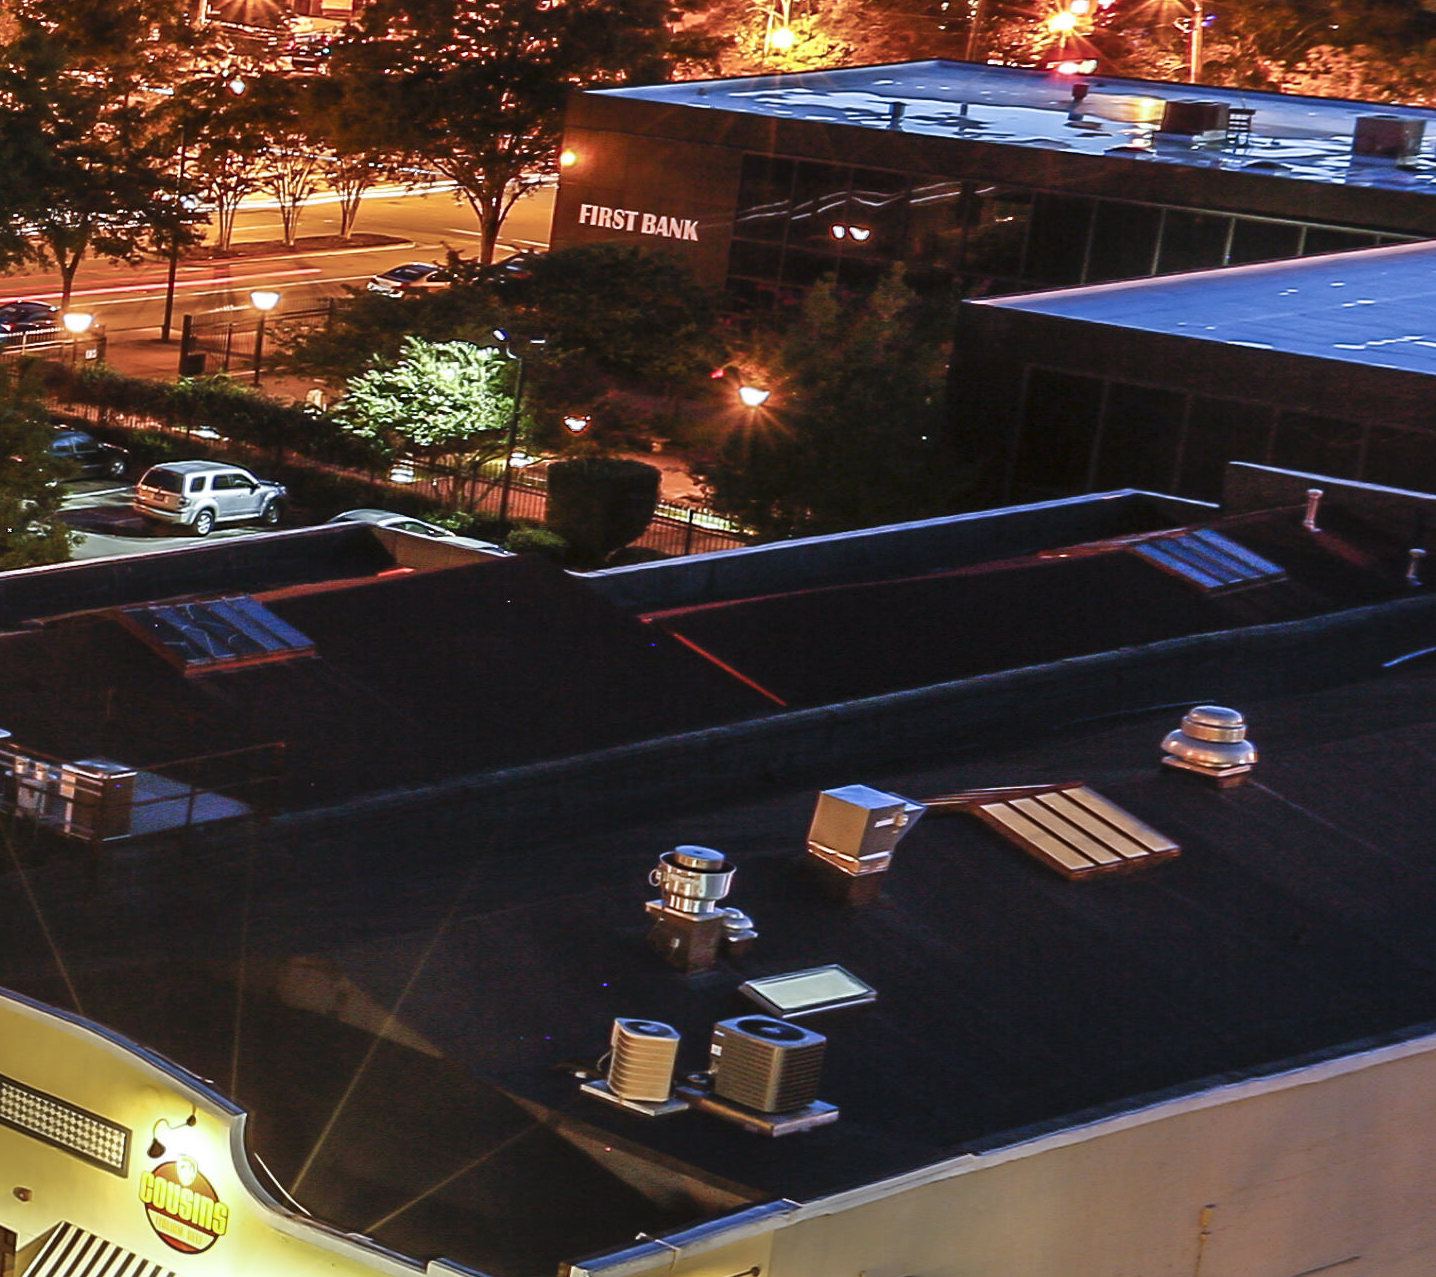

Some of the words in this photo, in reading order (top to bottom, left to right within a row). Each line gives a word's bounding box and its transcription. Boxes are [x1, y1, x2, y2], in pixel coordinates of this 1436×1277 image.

[579, 204, 639, 232] FIRST
[641, 213, 699, 242] BANK
[138, 1170, 229, 1236] COUSINS
